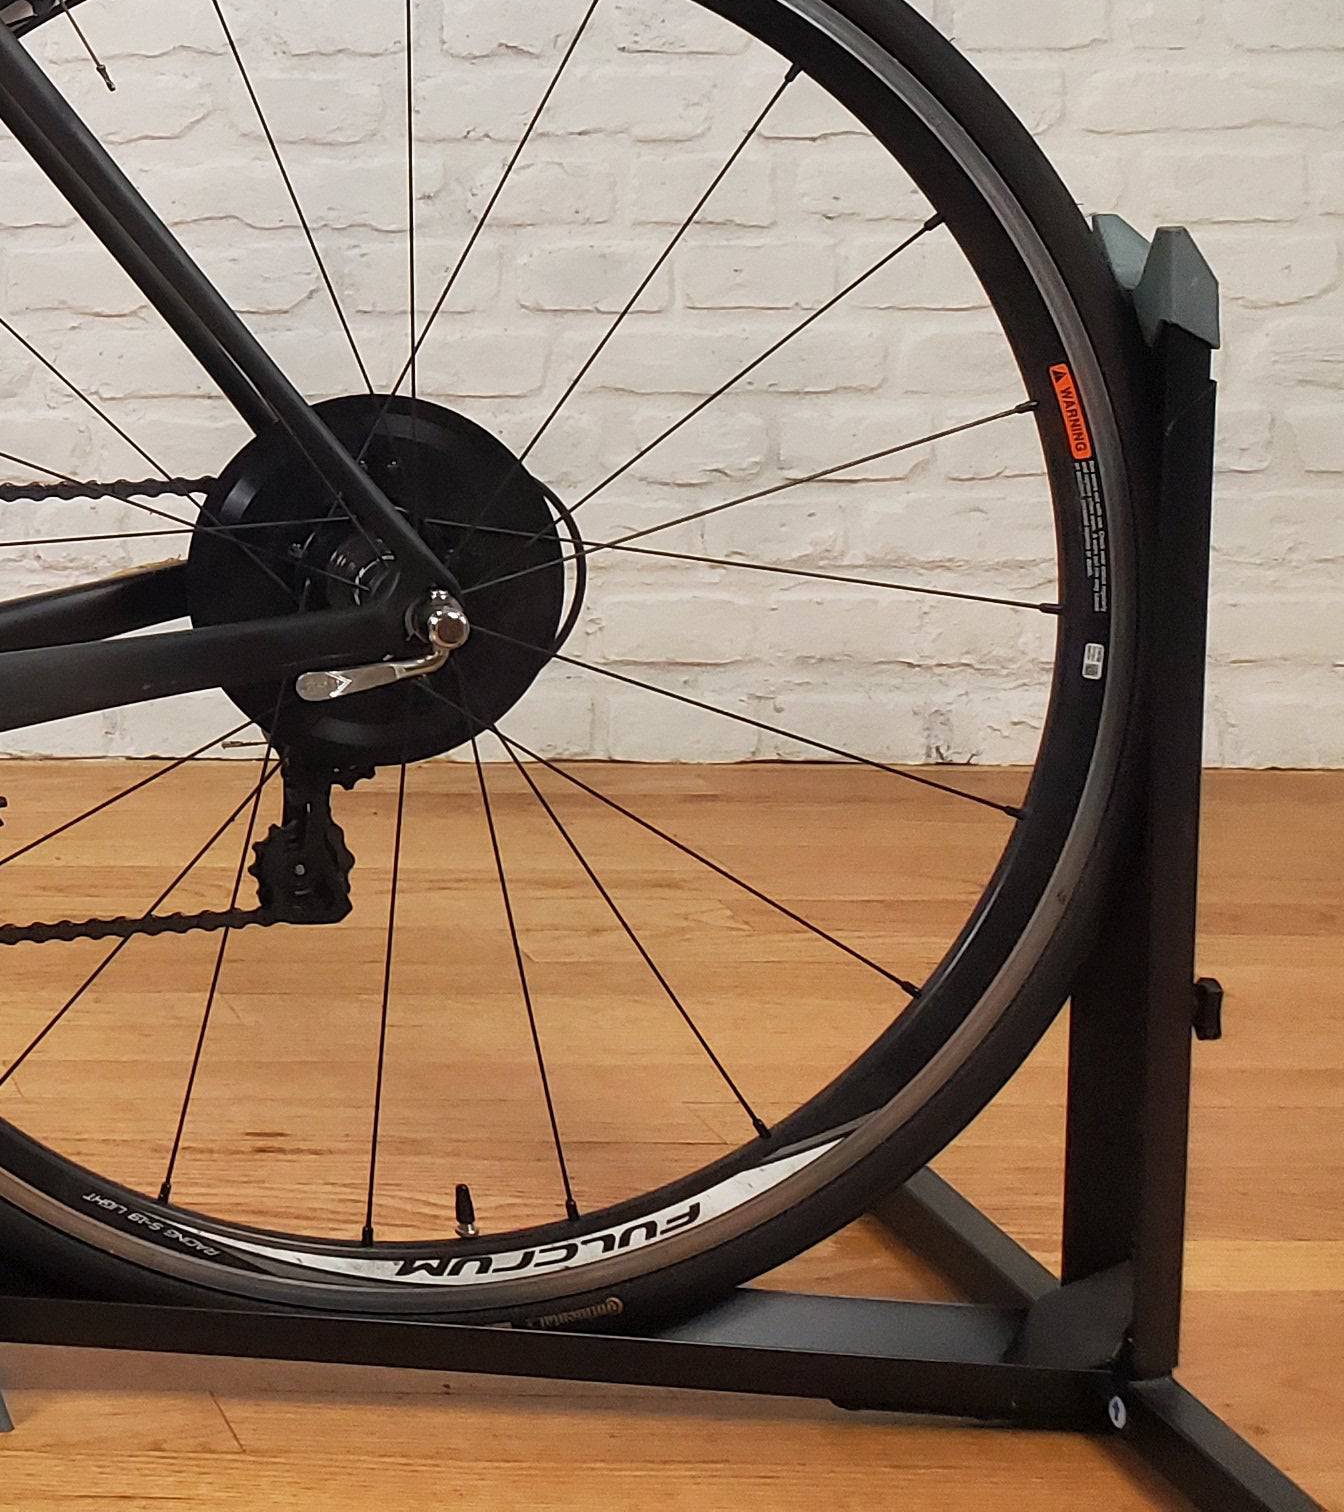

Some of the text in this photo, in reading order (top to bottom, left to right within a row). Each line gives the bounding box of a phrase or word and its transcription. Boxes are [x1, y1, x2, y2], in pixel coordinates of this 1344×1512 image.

[1062, 387, 1087, 452] WARNING
[82, 1193, 128, 1214] LIGHT
[163, 1229, 221, 1256] RACING
[396, 1202, 701, 1279] FULCRUM
